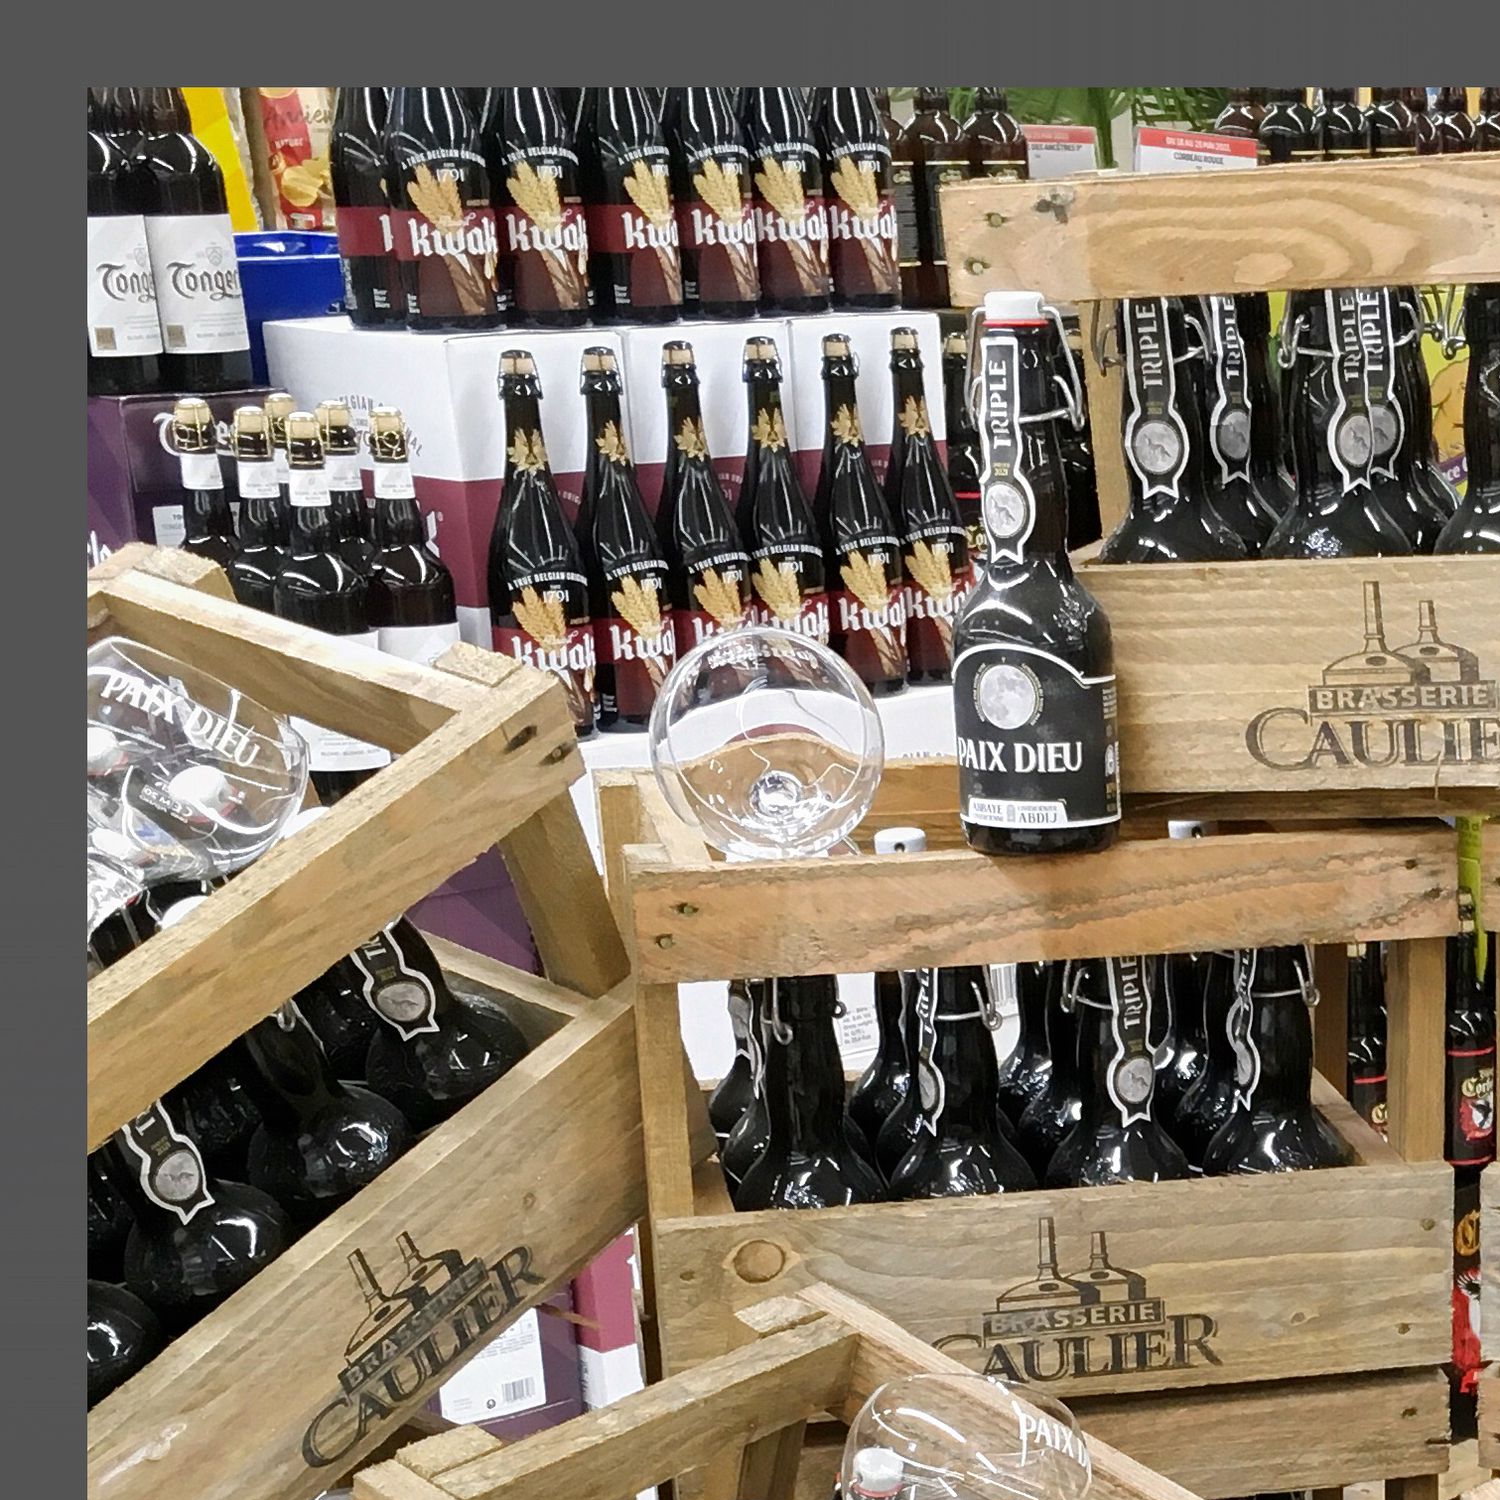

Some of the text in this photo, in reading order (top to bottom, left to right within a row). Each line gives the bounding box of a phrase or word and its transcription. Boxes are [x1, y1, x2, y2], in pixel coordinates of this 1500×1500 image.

[1141, 301, 1164, 387] TRIPLE
[991, 358, 1013, 450] TRIPLE
[770, 543, 800, 555] BELGIAN
[534, 571, 566, 583] BELGIAN
[1316, 685, 1490, 710] BRASSERIE
[184, 702, 261, 768] DIEU
[957, 735, 1083, 774] PAIX DIEU
[1018, 811, 1058, 824] ABDIJ
[345, 1262, 486, 1390] BRASSERIE
[990, 1306, 1156, 1333] BRASSERIE
[301, 1244, 546, 1468] CAULIER
